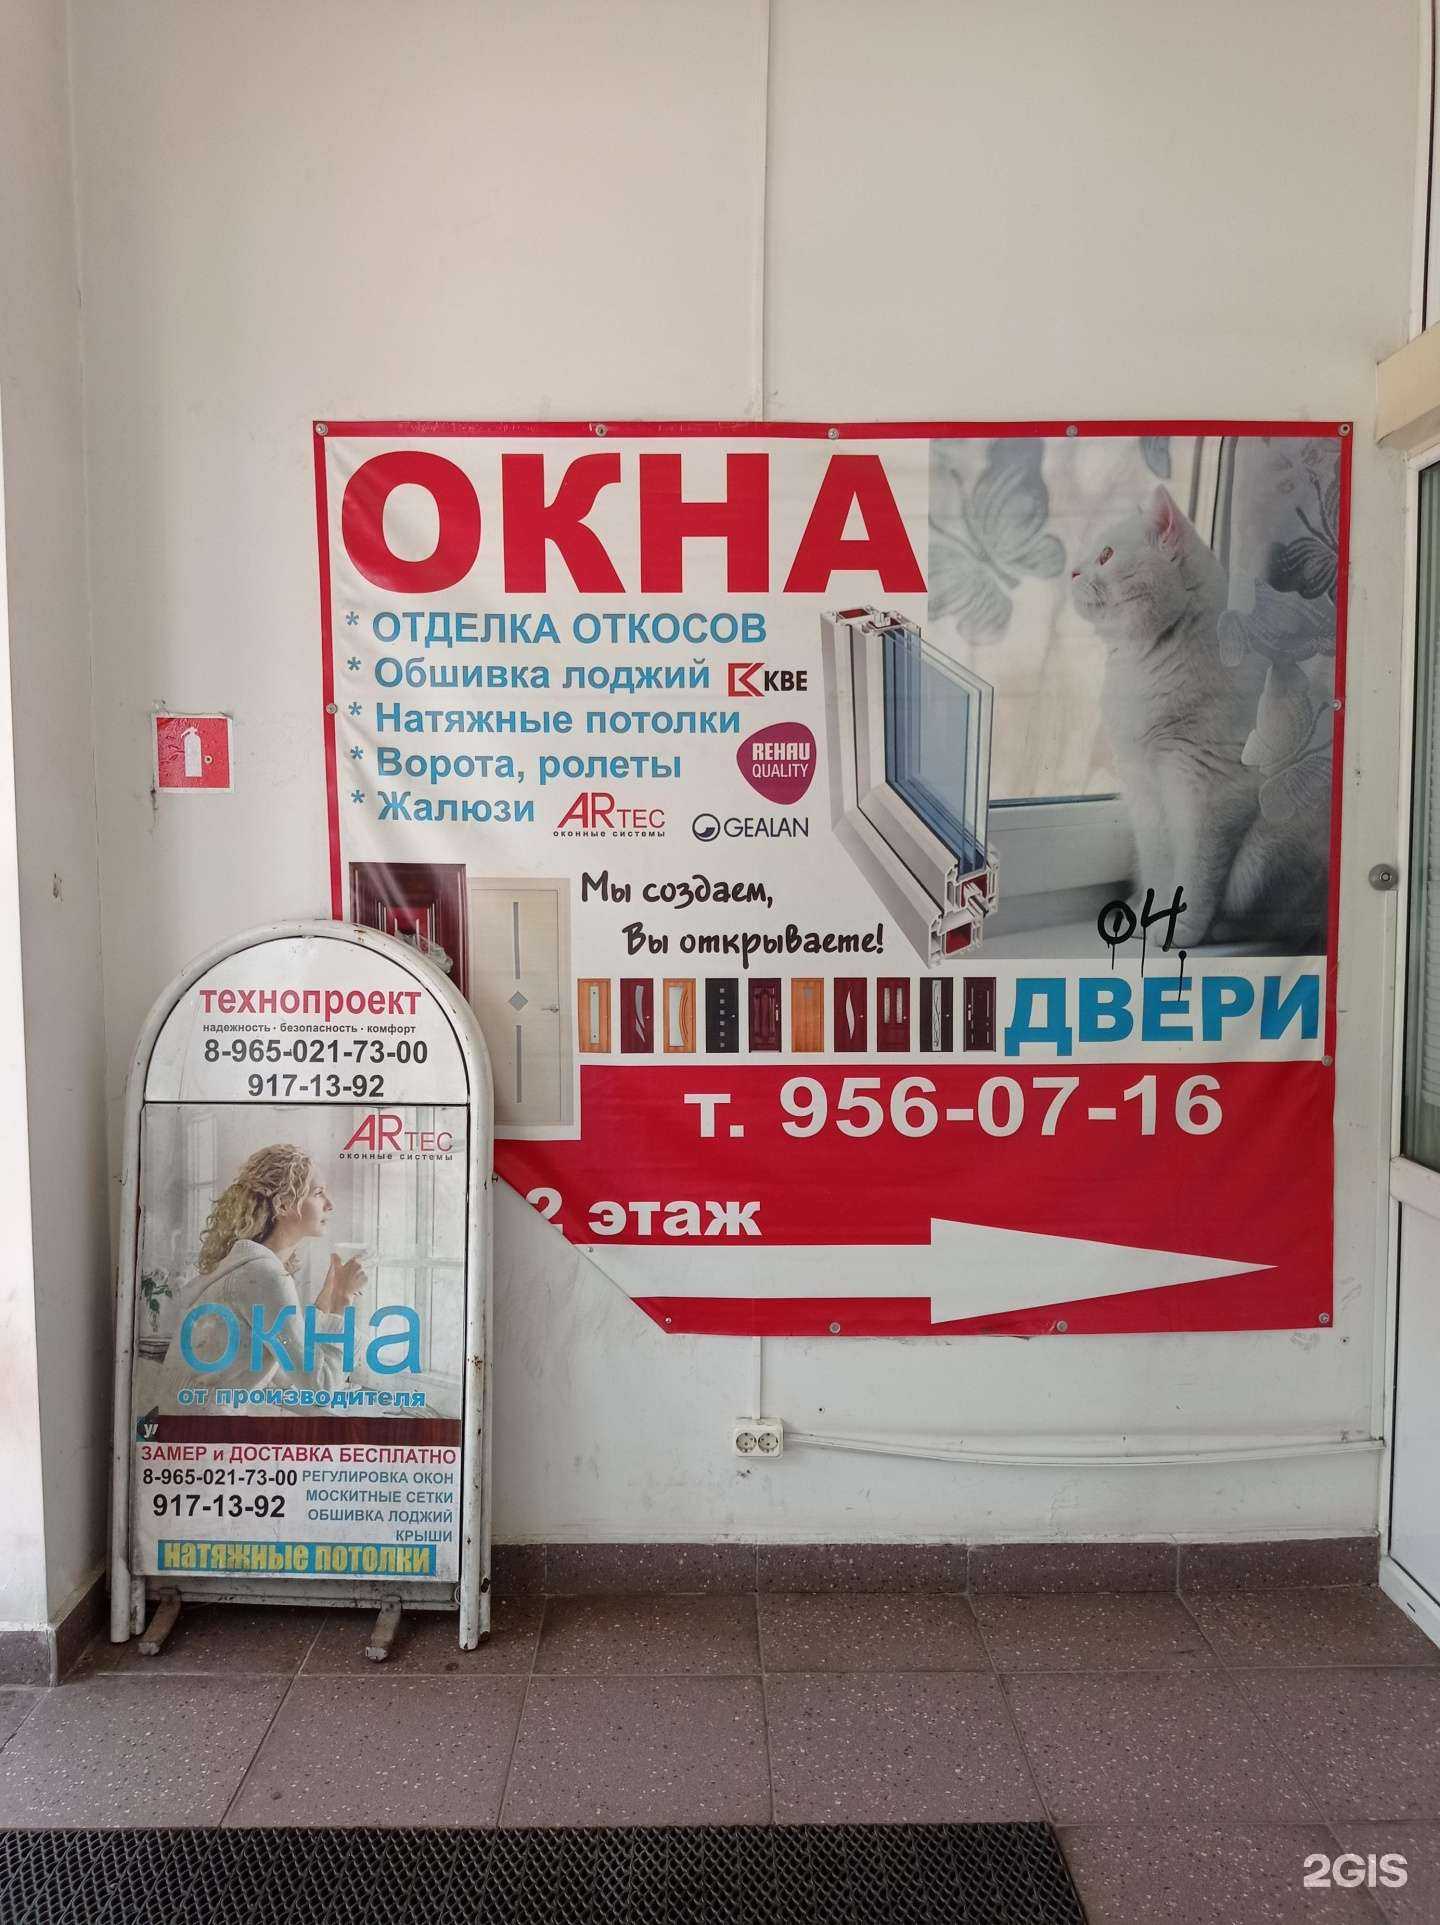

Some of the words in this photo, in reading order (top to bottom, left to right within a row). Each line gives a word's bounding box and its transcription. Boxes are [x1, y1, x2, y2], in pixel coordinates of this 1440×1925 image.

[341, 449, 928, 594] ОКНА
[372, 612, 561, 649] ОТДЕЛКА
[573, 612, 767, 644] ОТКОСОВ
[374, 656, 551, 689] Обшивка
[562, 659, 711, 694] лоджий
[376, 702, 573, 735] Натяжные
[586, 710, 740, 734] потолки
[752, 742, 811, 761] REHAU
[378, 746, 525, 784] Ворота,
[539, 754, 681, 785] ролеты
[752, 763, 809, 778] QUALITY
[378, 791, 535, 823] Жалюзи
[723, 817, 809, 838] GEALAN
[581, 870, 631, 902] Мы
[642, 874, 774, 909] создаем,
[622, 921, 668, 956] Вы
[680, 923, 884, 969] открываете!
[199, 988, 421, 1022] технопроект
[1004, 974, 1320, 1057] ДВЕРИ
[203, 1023, 271, 1034] надежность
[280, 1023, 358, 1034] безопасность
[367, 1025, 417, 1036] комфорт
[204, 1038, 429, 1064] 8-965-021-73-00
[248, 1074, 385, 1098] 917-13-92
[684, 1093, 745, 1138] т.
[779, 1075, 1224, 1138] 956-07-16
[588, 1200, 763, 1237] этаж
[180, 1303, 422, 1375] окна
[177, 1388, 209, 1406] от
[216, 1388, 427, 1409] производителя
[141, 1445, 208, 1462] ЗАМЕР
[213, 1450, 225, 1462] и
[229, 1446, 334, 1466] ДОСТАВКА
[339, 1447, 457, 1464] БЕСПЛАТНО
[143, 1468, 298, 1487] 8-965-021-73-00
[302, 1470, 409, 1485] РЕГУЛИРОВКА
[413, 1471, 454, 1485] ОКОН
[152, 1494, 286, 1519] 917-13-92
[305, 1488, 401, 1504] МОСКИТНЫЕ
[405, 1490, 454, 1504] СЕТКИ
[308, 1508, 384, 1523] ОБШИВКА
[388, 1507, 454, 1525] ЛОДЖИЙ
[396, 1530, 453, 1543] КРЫШИ
[315, 1546, 430, 1573] потолки
